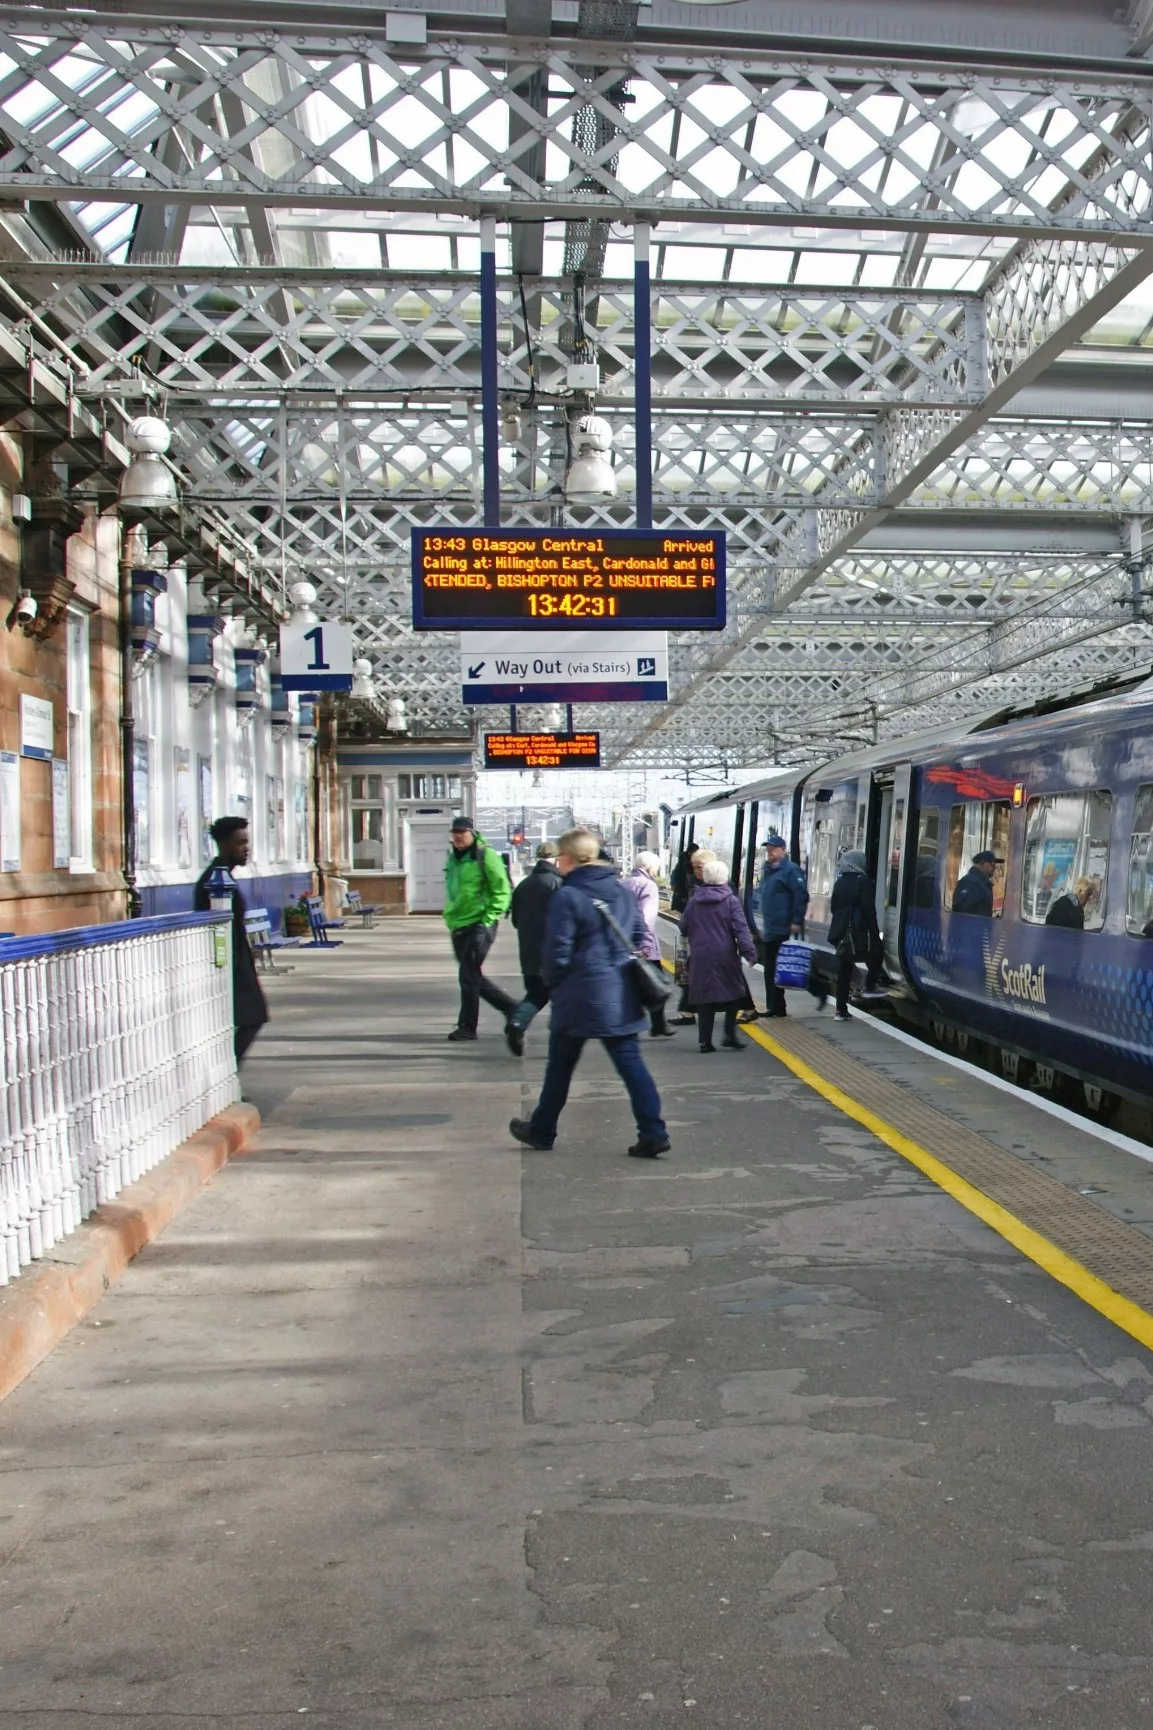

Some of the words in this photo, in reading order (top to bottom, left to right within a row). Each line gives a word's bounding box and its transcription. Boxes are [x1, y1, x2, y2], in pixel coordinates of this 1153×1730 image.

[424, 537, 467, 551] 13:43
[472, 538, 537, 556] Glasgow
[542, 539, 604, 553] Central
[663, 540, 715, 553] Arrived
[423, 556, 468, 572] Calling
[473, 556, 493, 570] at:
[496, 556, 558, 573] Hillington
[562, 556, 600, 572] East,
[603, 557, 669, 571] Cardonald
[673, 557, 697, 571] and
[498, 575, 578, 588] BISHOPTON
[583, 575, 604, 588] P2
[609, 575, 697, 588] UNSUITABLE
[527, 593, 617, 616] 13:42:31
[304, 627, 331, 670] 1
[495, 659, 528, 679] Way
[533, 658, 562, 674] Out
[567, 661, 590, 676] (via
[592, 660, 631, 675] Stairs)
[1001, 957, 1047, 1005] ScotRail
